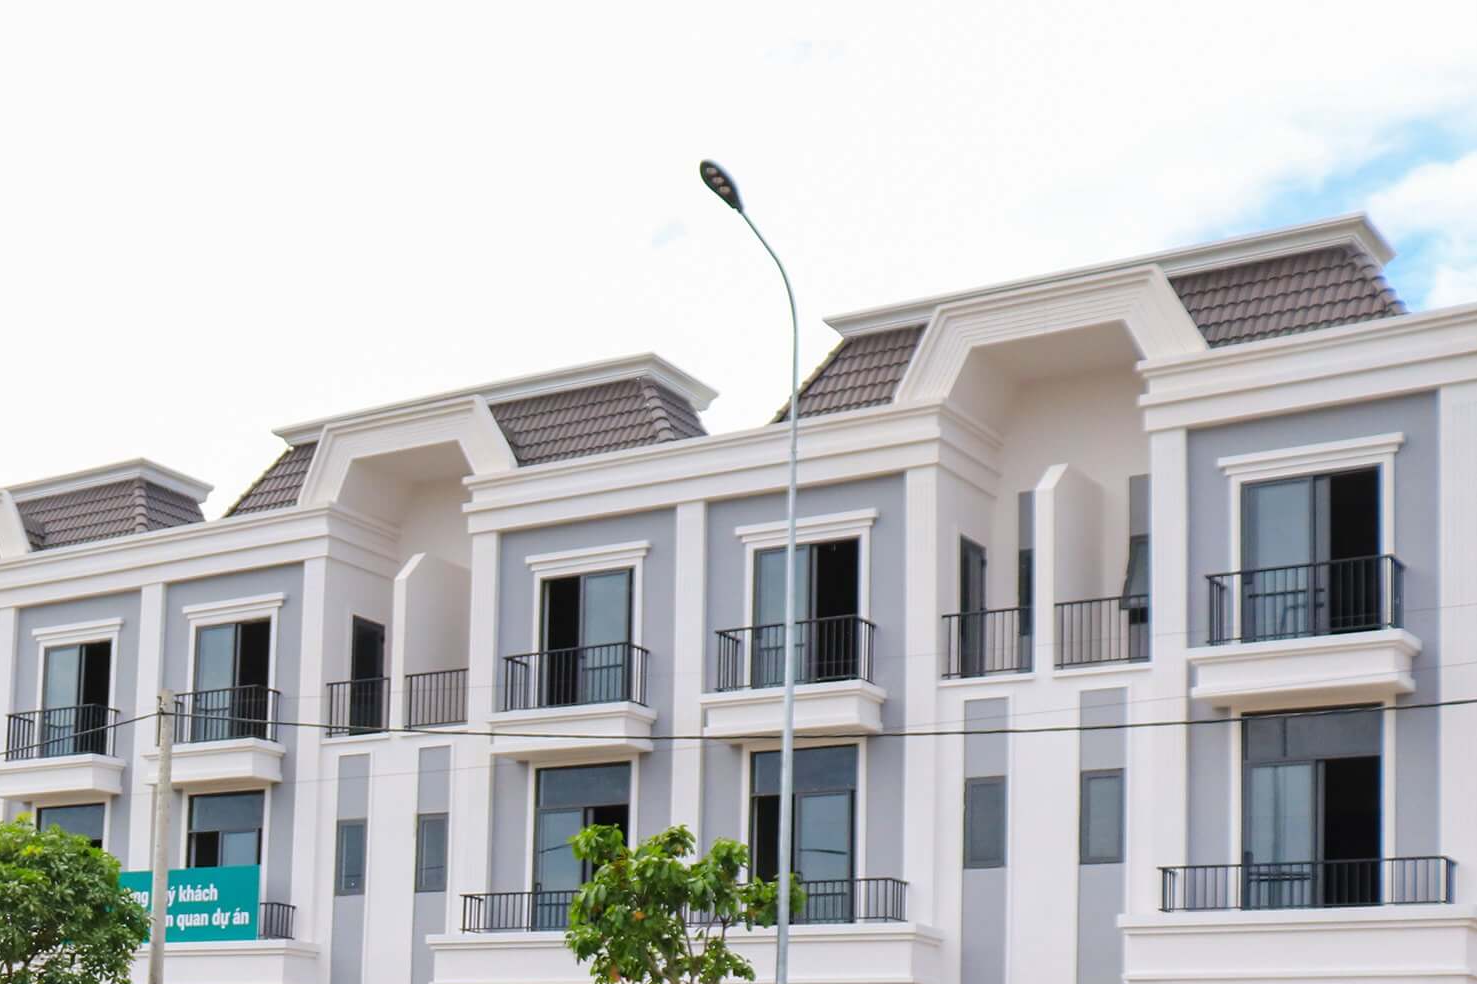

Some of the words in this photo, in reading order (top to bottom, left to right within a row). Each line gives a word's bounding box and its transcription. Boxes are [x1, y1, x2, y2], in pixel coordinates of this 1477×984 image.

[179, 884, 218, 902] khách
[177, 912, 209, 931] quan
[211, 908, 230, 929] dự
[232, 908, 249, 925] án
